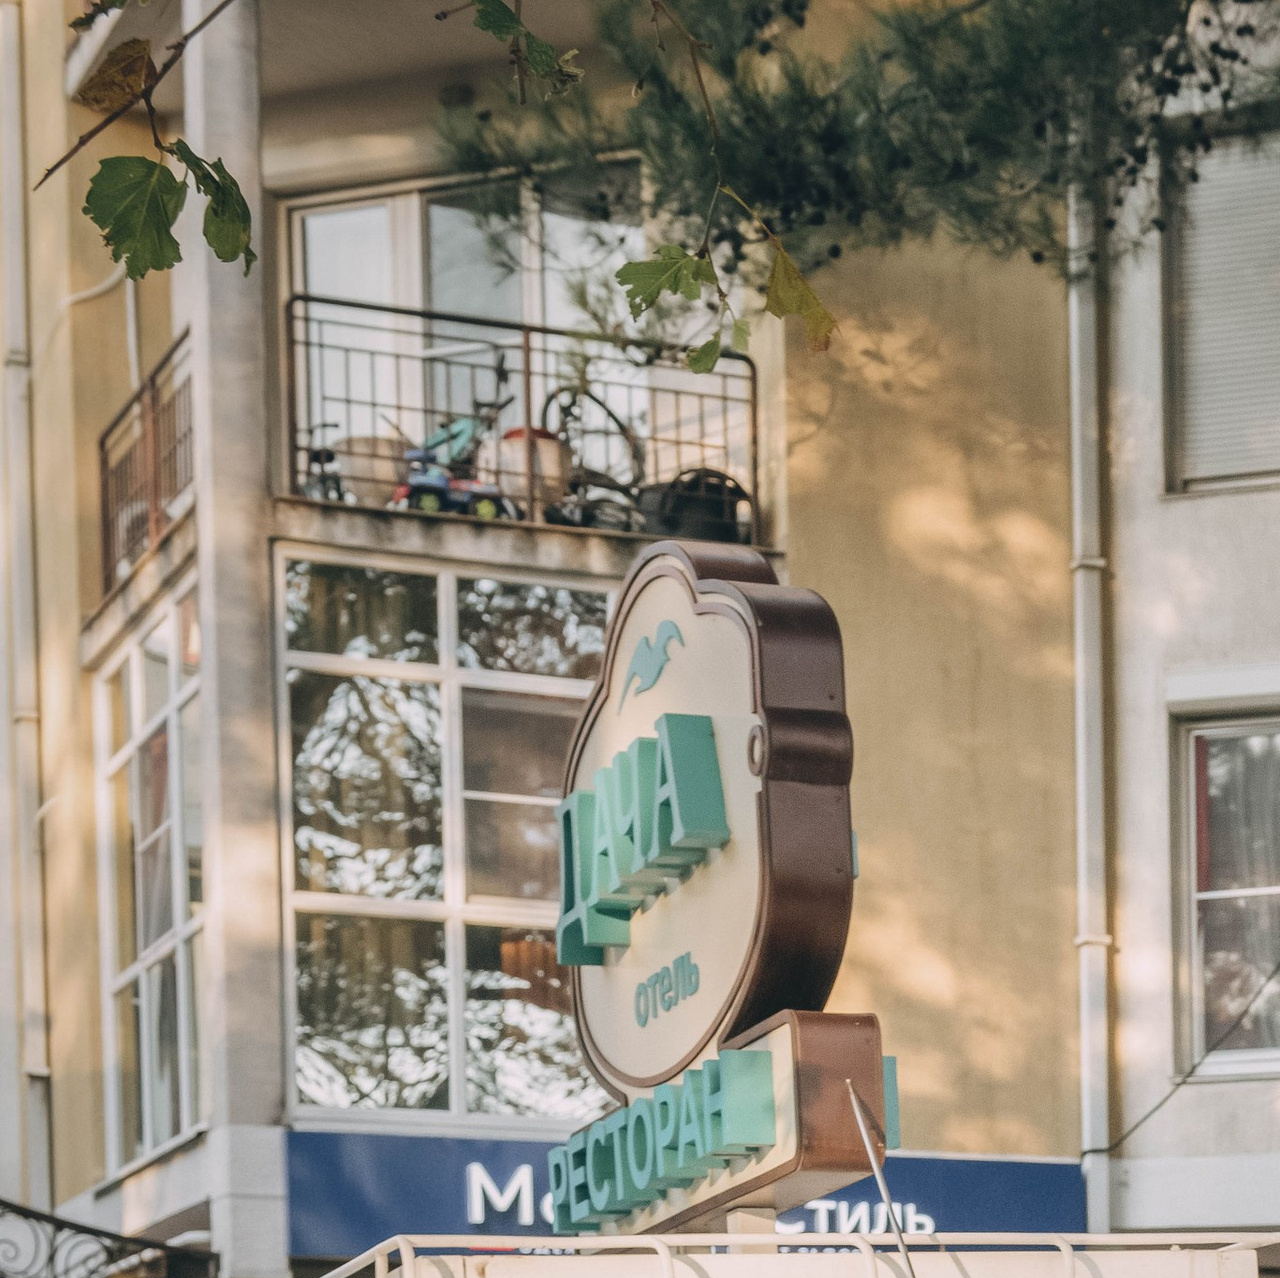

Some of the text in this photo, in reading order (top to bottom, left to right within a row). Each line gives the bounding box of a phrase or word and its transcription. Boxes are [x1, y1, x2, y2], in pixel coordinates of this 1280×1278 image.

[554, 713, 708, 965] ДАЧА
[635, 951, 700, 1028] отель
[548, 1050, 752, 1234] РЕСТОРАН
